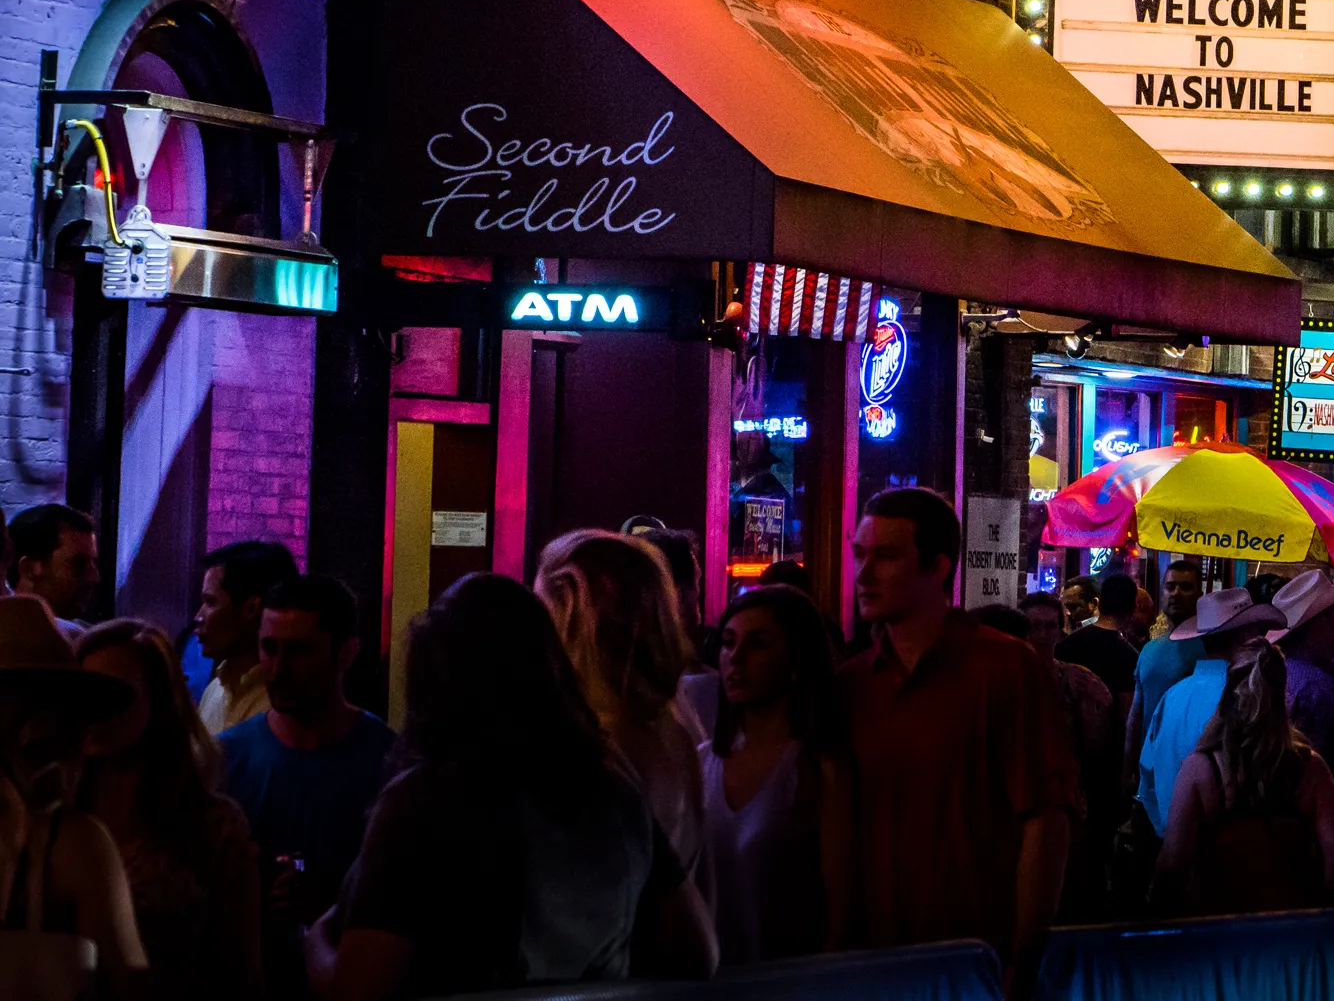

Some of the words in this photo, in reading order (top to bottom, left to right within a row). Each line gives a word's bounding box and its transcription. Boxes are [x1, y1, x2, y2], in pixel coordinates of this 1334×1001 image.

[1195, 35, 1234, 68] TO
[1135, 74, 1312, 112] NASHVILLE
[427, 103, 675, 170] Second
[422, 170, 676, 237] Fiddle
[511, 292, 639, 322] ATM
[746, 503, 783, 519] WELCOME
[988, 524, 1000, 542] THE
[1161, 520, 1232, 548] Vienna
[1236, 529, 1284, 557] Beef
[967, 550, 992, 569] ROBERT
[995, 551, 1017, 570] MOORE
